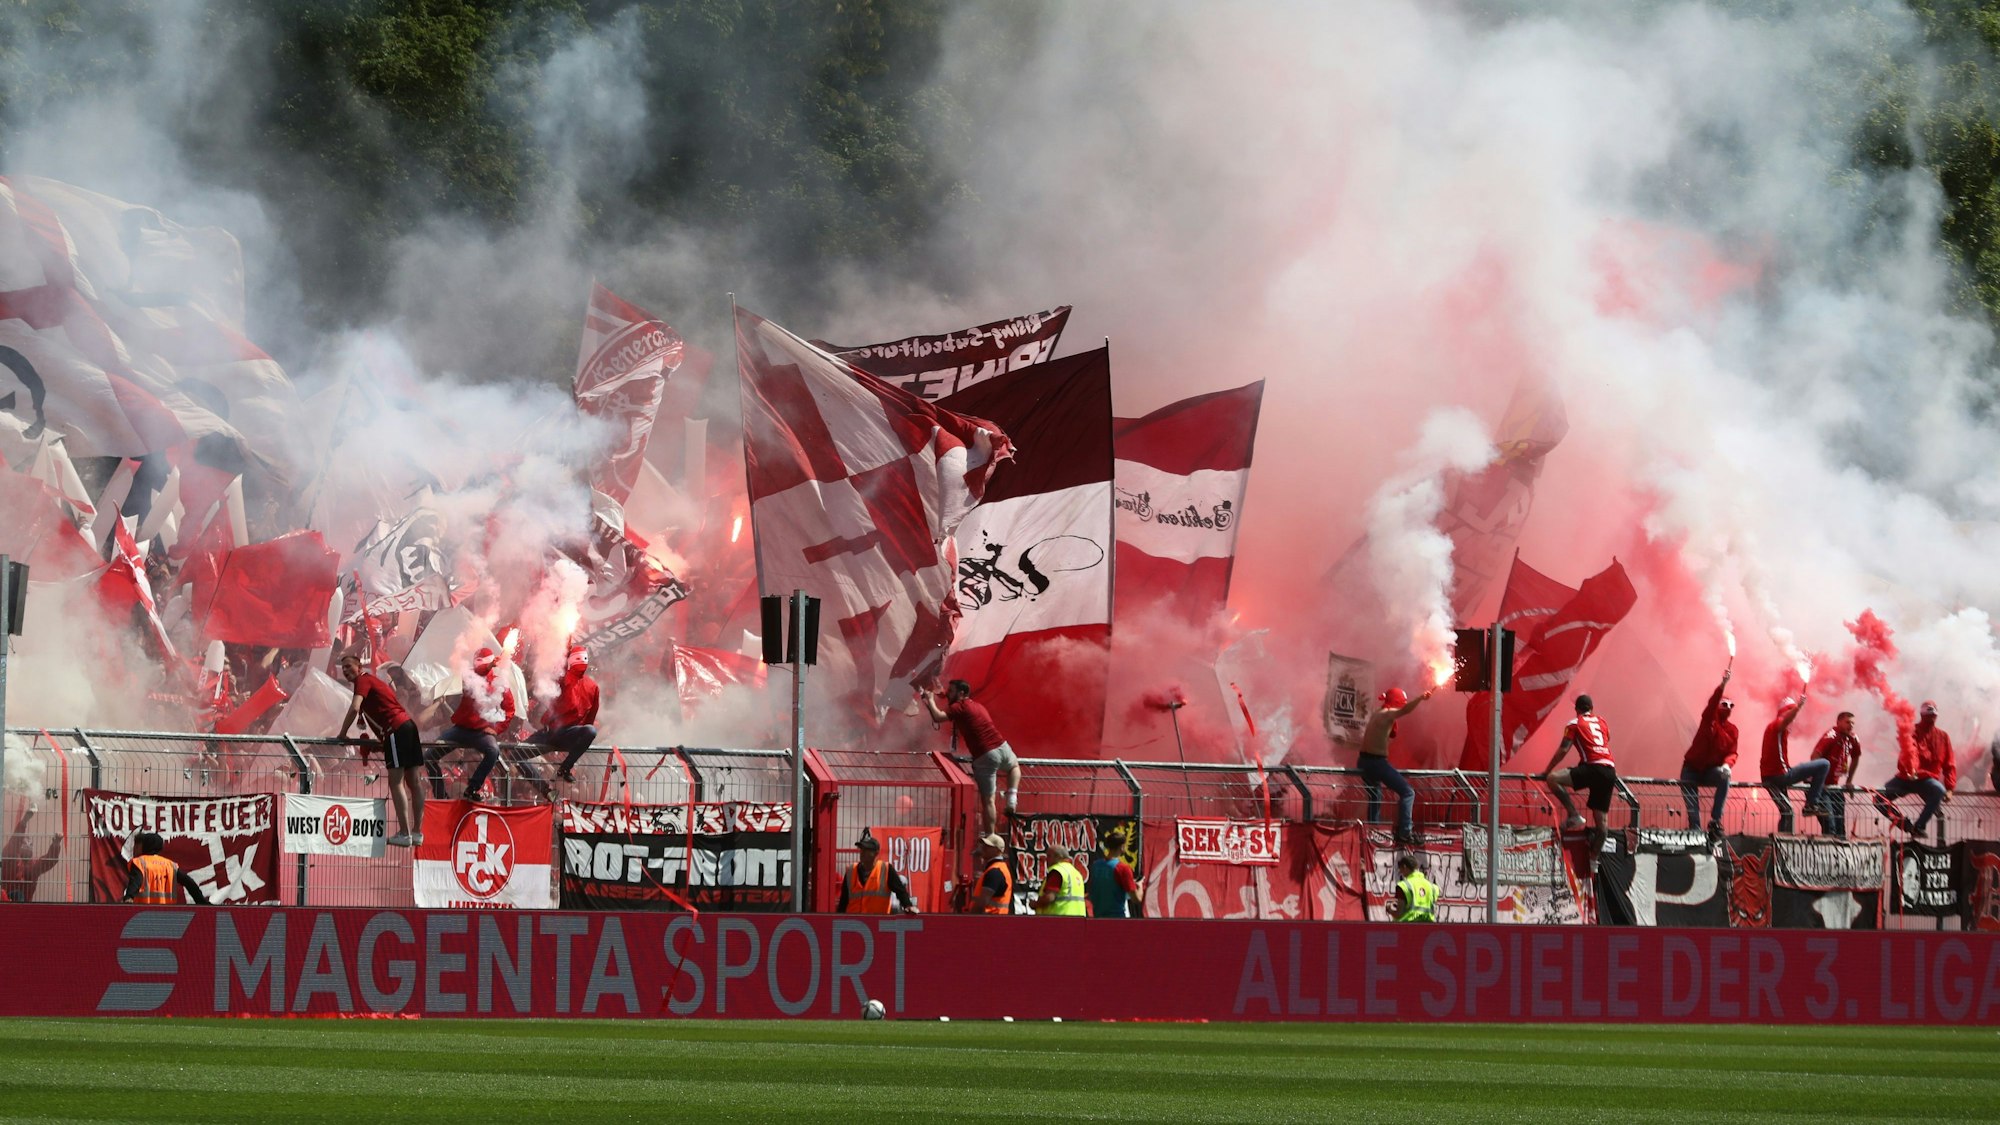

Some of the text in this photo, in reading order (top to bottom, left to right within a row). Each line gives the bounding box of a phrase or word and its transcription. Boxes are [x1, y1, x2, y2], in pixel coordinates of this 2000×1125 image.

[1334, 691, 1354, 711] FCK
[1588, 722, 1604, 746] 5
[287, 816, 320, 834] WEST
[352, 818, 384, 838] BOYS
[1009, 818, 1098, 853] K-TOWN
[1181, 827, 1221, 852] SEK
[564, 837, 792, 887] ROT-FRONT
[1926, 871, 1949, 889] FÜR
[214, 913, 923, 1015] MAGENTA SPORT
[1232, 929, 2000, 1020] ALLE SPIELE DER 3. LIGA
